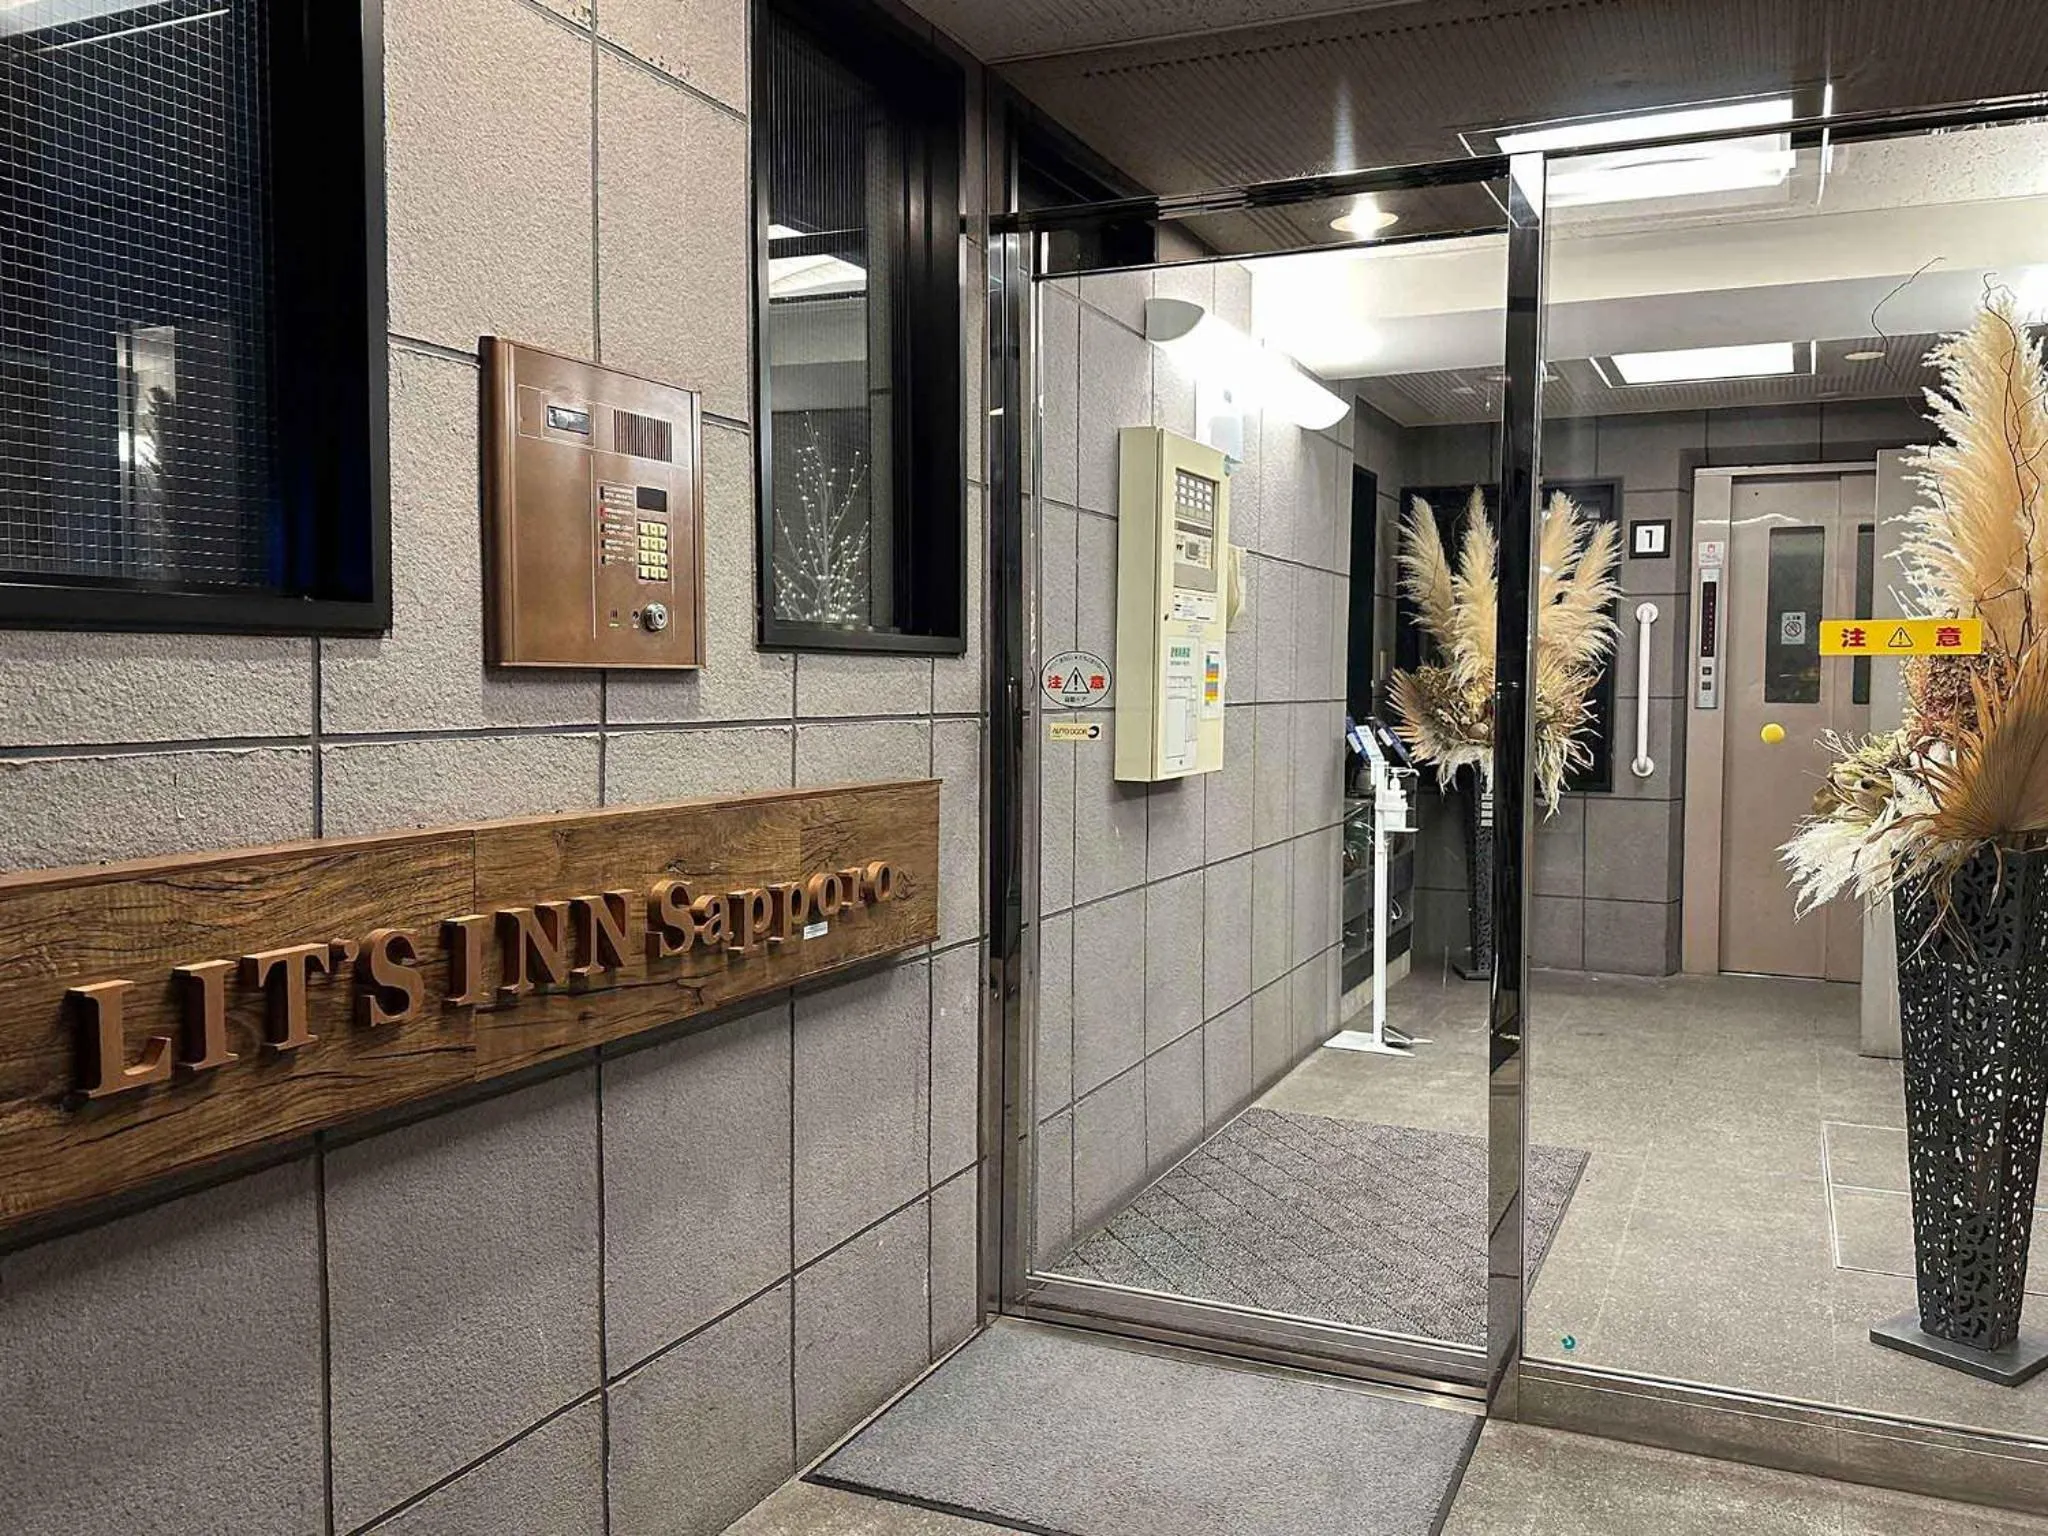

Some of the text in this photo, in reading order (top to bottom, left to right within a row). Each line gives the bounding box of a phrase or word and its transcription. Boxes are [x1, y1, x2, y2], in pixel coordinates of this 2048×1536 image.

[1644, 529, 1654, 549] 1
[64, 860, 897, 1099] LIT'S INN Sapporo
